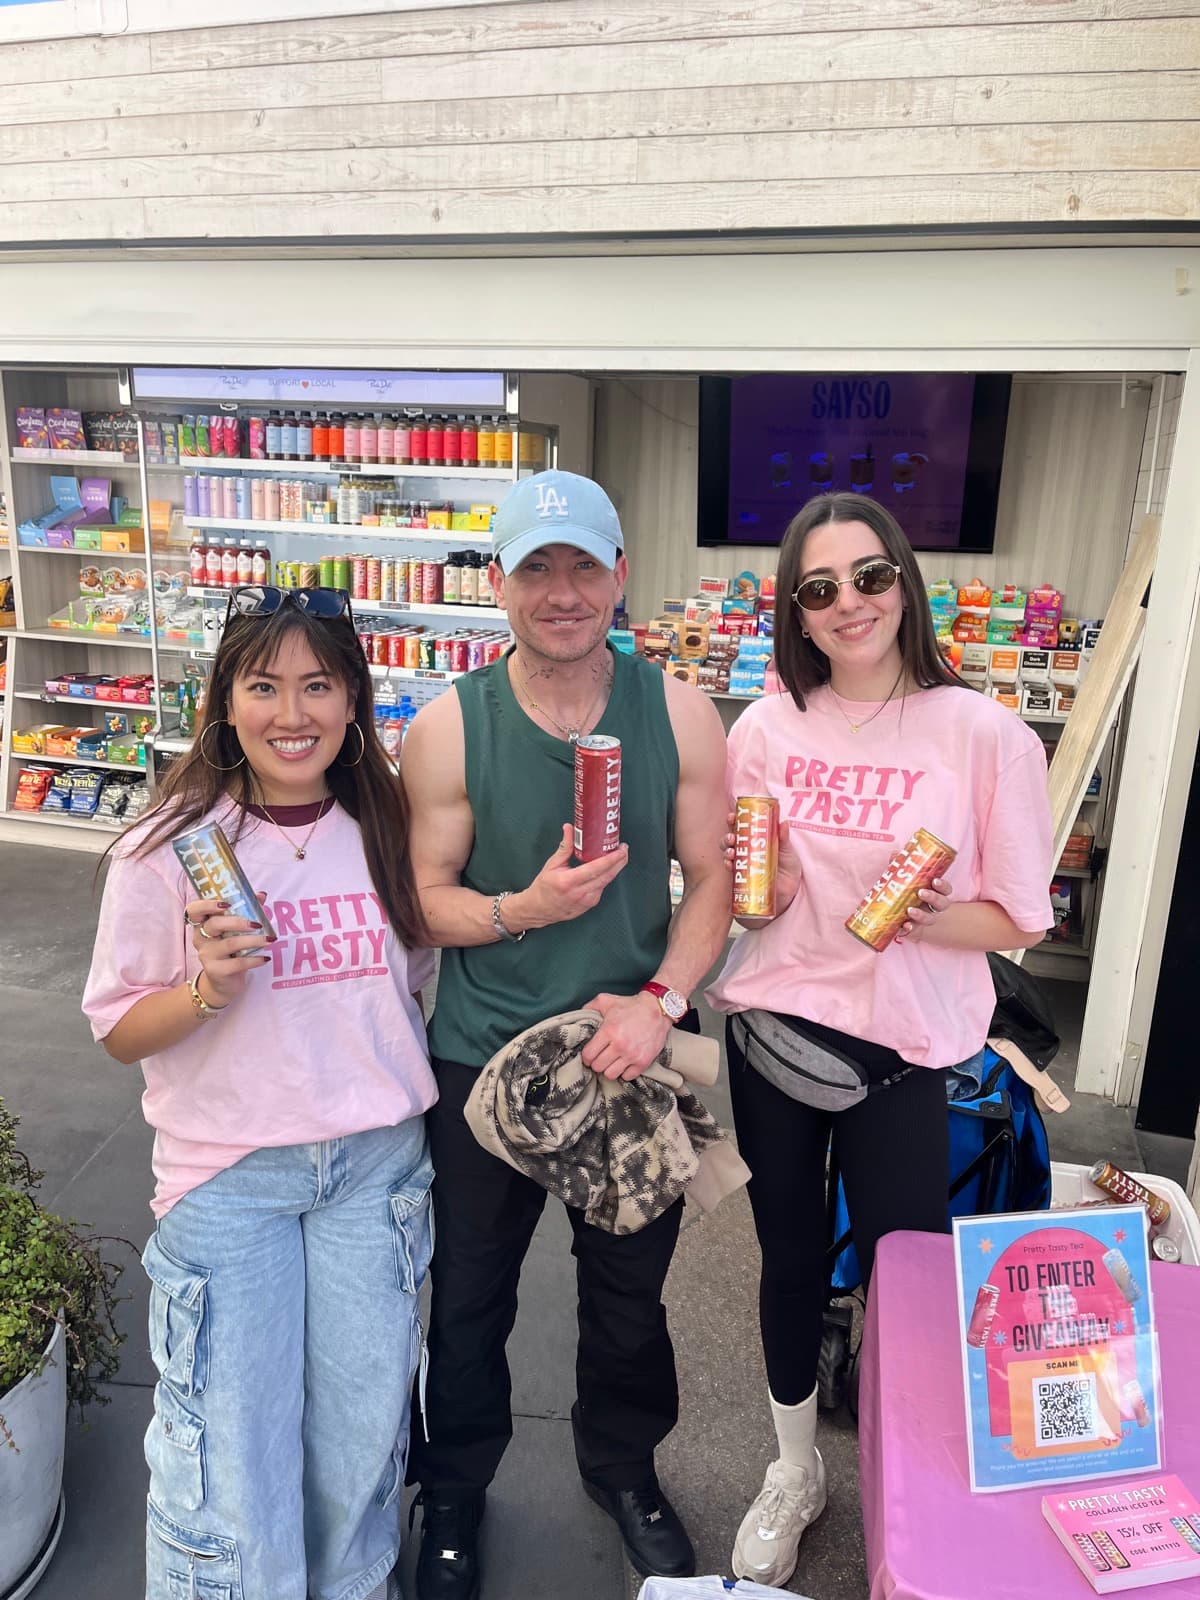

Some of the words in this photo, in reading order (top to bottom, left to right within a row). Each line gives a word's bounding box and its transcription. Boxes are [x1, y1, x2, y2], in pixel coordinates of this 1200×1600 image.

[811, 380, 891, 419] SAYSO
[535, 482, 569, 519] LA
[605, 757, 620, 835] PRETTY
[785, 756, 926, 800] PRETTY
[788, 791, 904, 830] TASTY
[734, 805, 750, 884] PRETTY
[749, 811, 768, 878] TASTY
[876, 845, 930, 908] TASTY
[265, 892, 389, 936] RETTY
[266, 929, 386, 977] TASTY
[1111, 1171, 1150, 1202] TASTY
[1023, 1246, 1046, 1254] Pretty
[1047, 1244, 1069, 1253] Tasty
[1005, 1264, 1029, 1292] TO
[1036, 1260, 1095, 1290] ENTER
[1038, 1290, 1073, 1319] THE
[1012, 1317, 1110, 1353] GIVEAWAY
[1046, 1361, 1068, 1369] SCAN
[1068, 1494, 1118, 1511] PRETTY
[1122, 1485, 1167, 1502] TASTY
[1086, 1506, 1129, 1517] COLLAGEN
[1130, 1501, 1149, 1510] ICED
[1150, 1499, 1165, 1507] TEA
[1117, 1526, 1140, 1538] 15%
[1142, 1521, 1164, 1535] OFF
